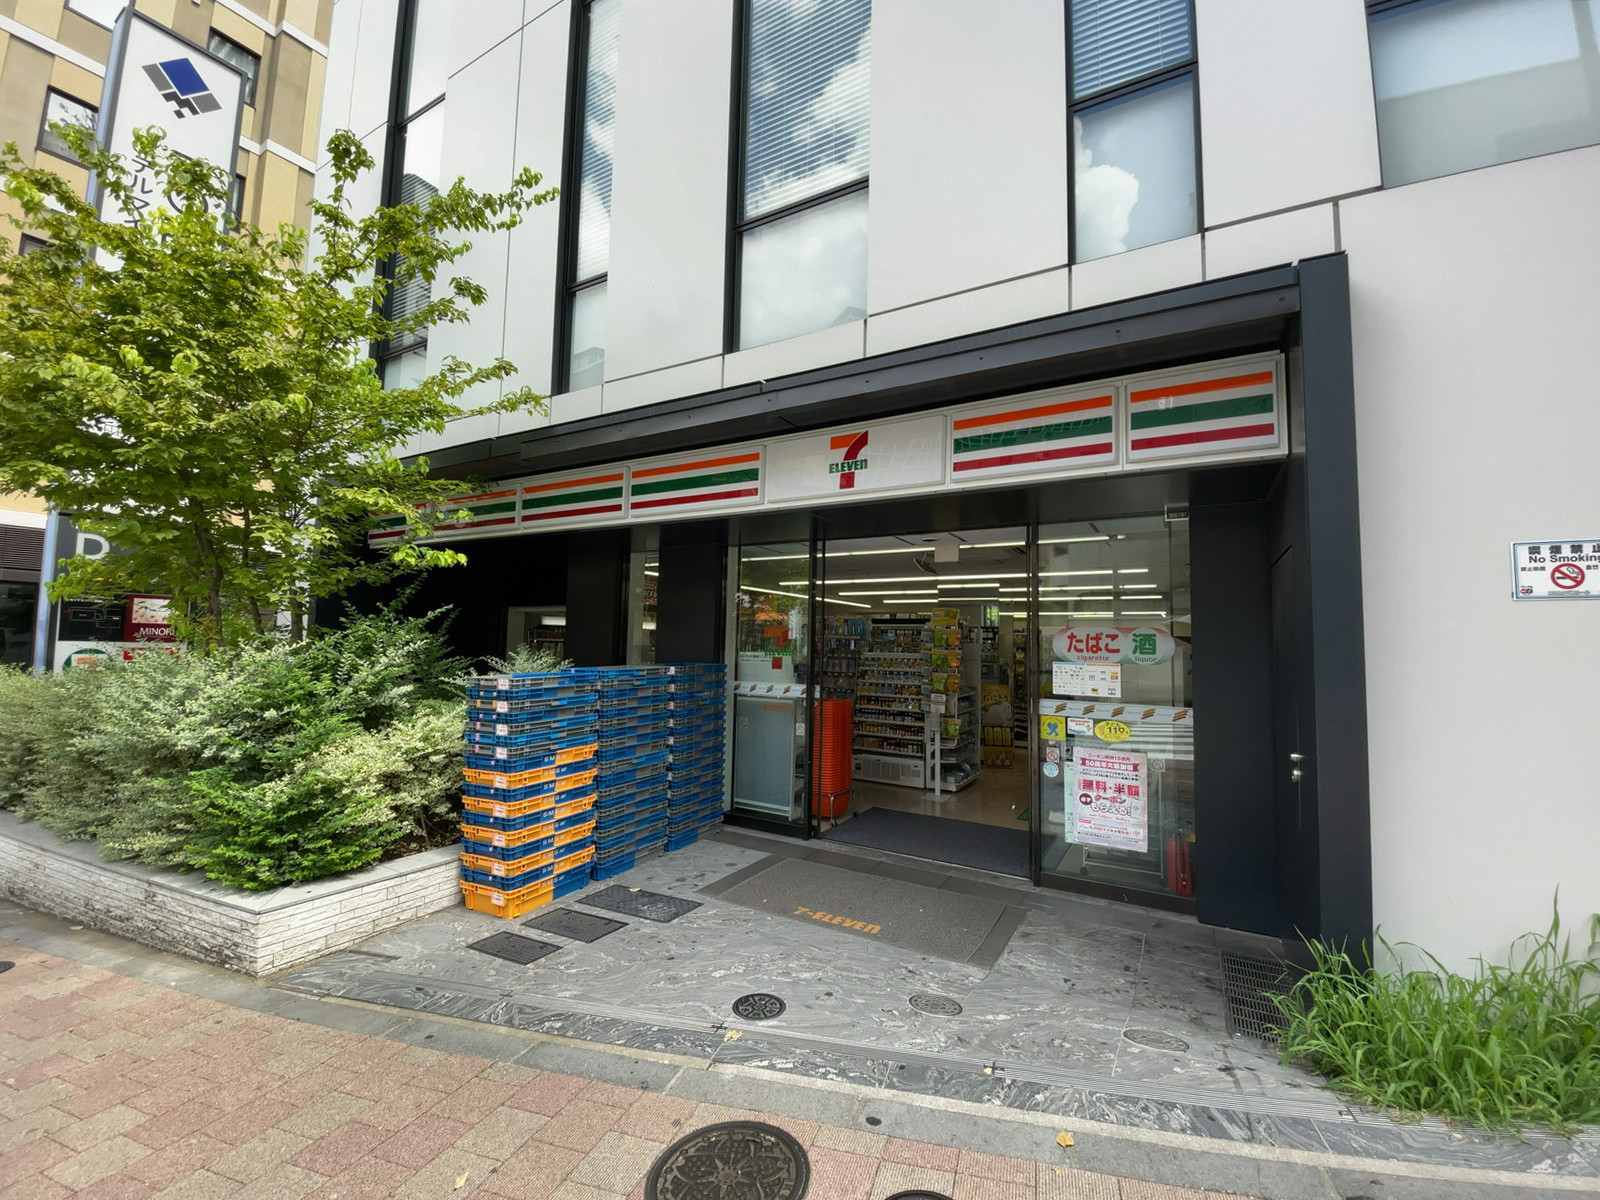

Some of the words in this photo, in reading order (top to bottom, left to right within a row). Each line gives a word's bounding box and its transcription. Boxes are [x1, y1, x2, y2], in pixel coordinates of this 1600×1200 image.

[1529, 555, 1546, 563] No
[1067, 632, 1121, 654] たばこ
[1132, 633, 1157, 655] 酒
